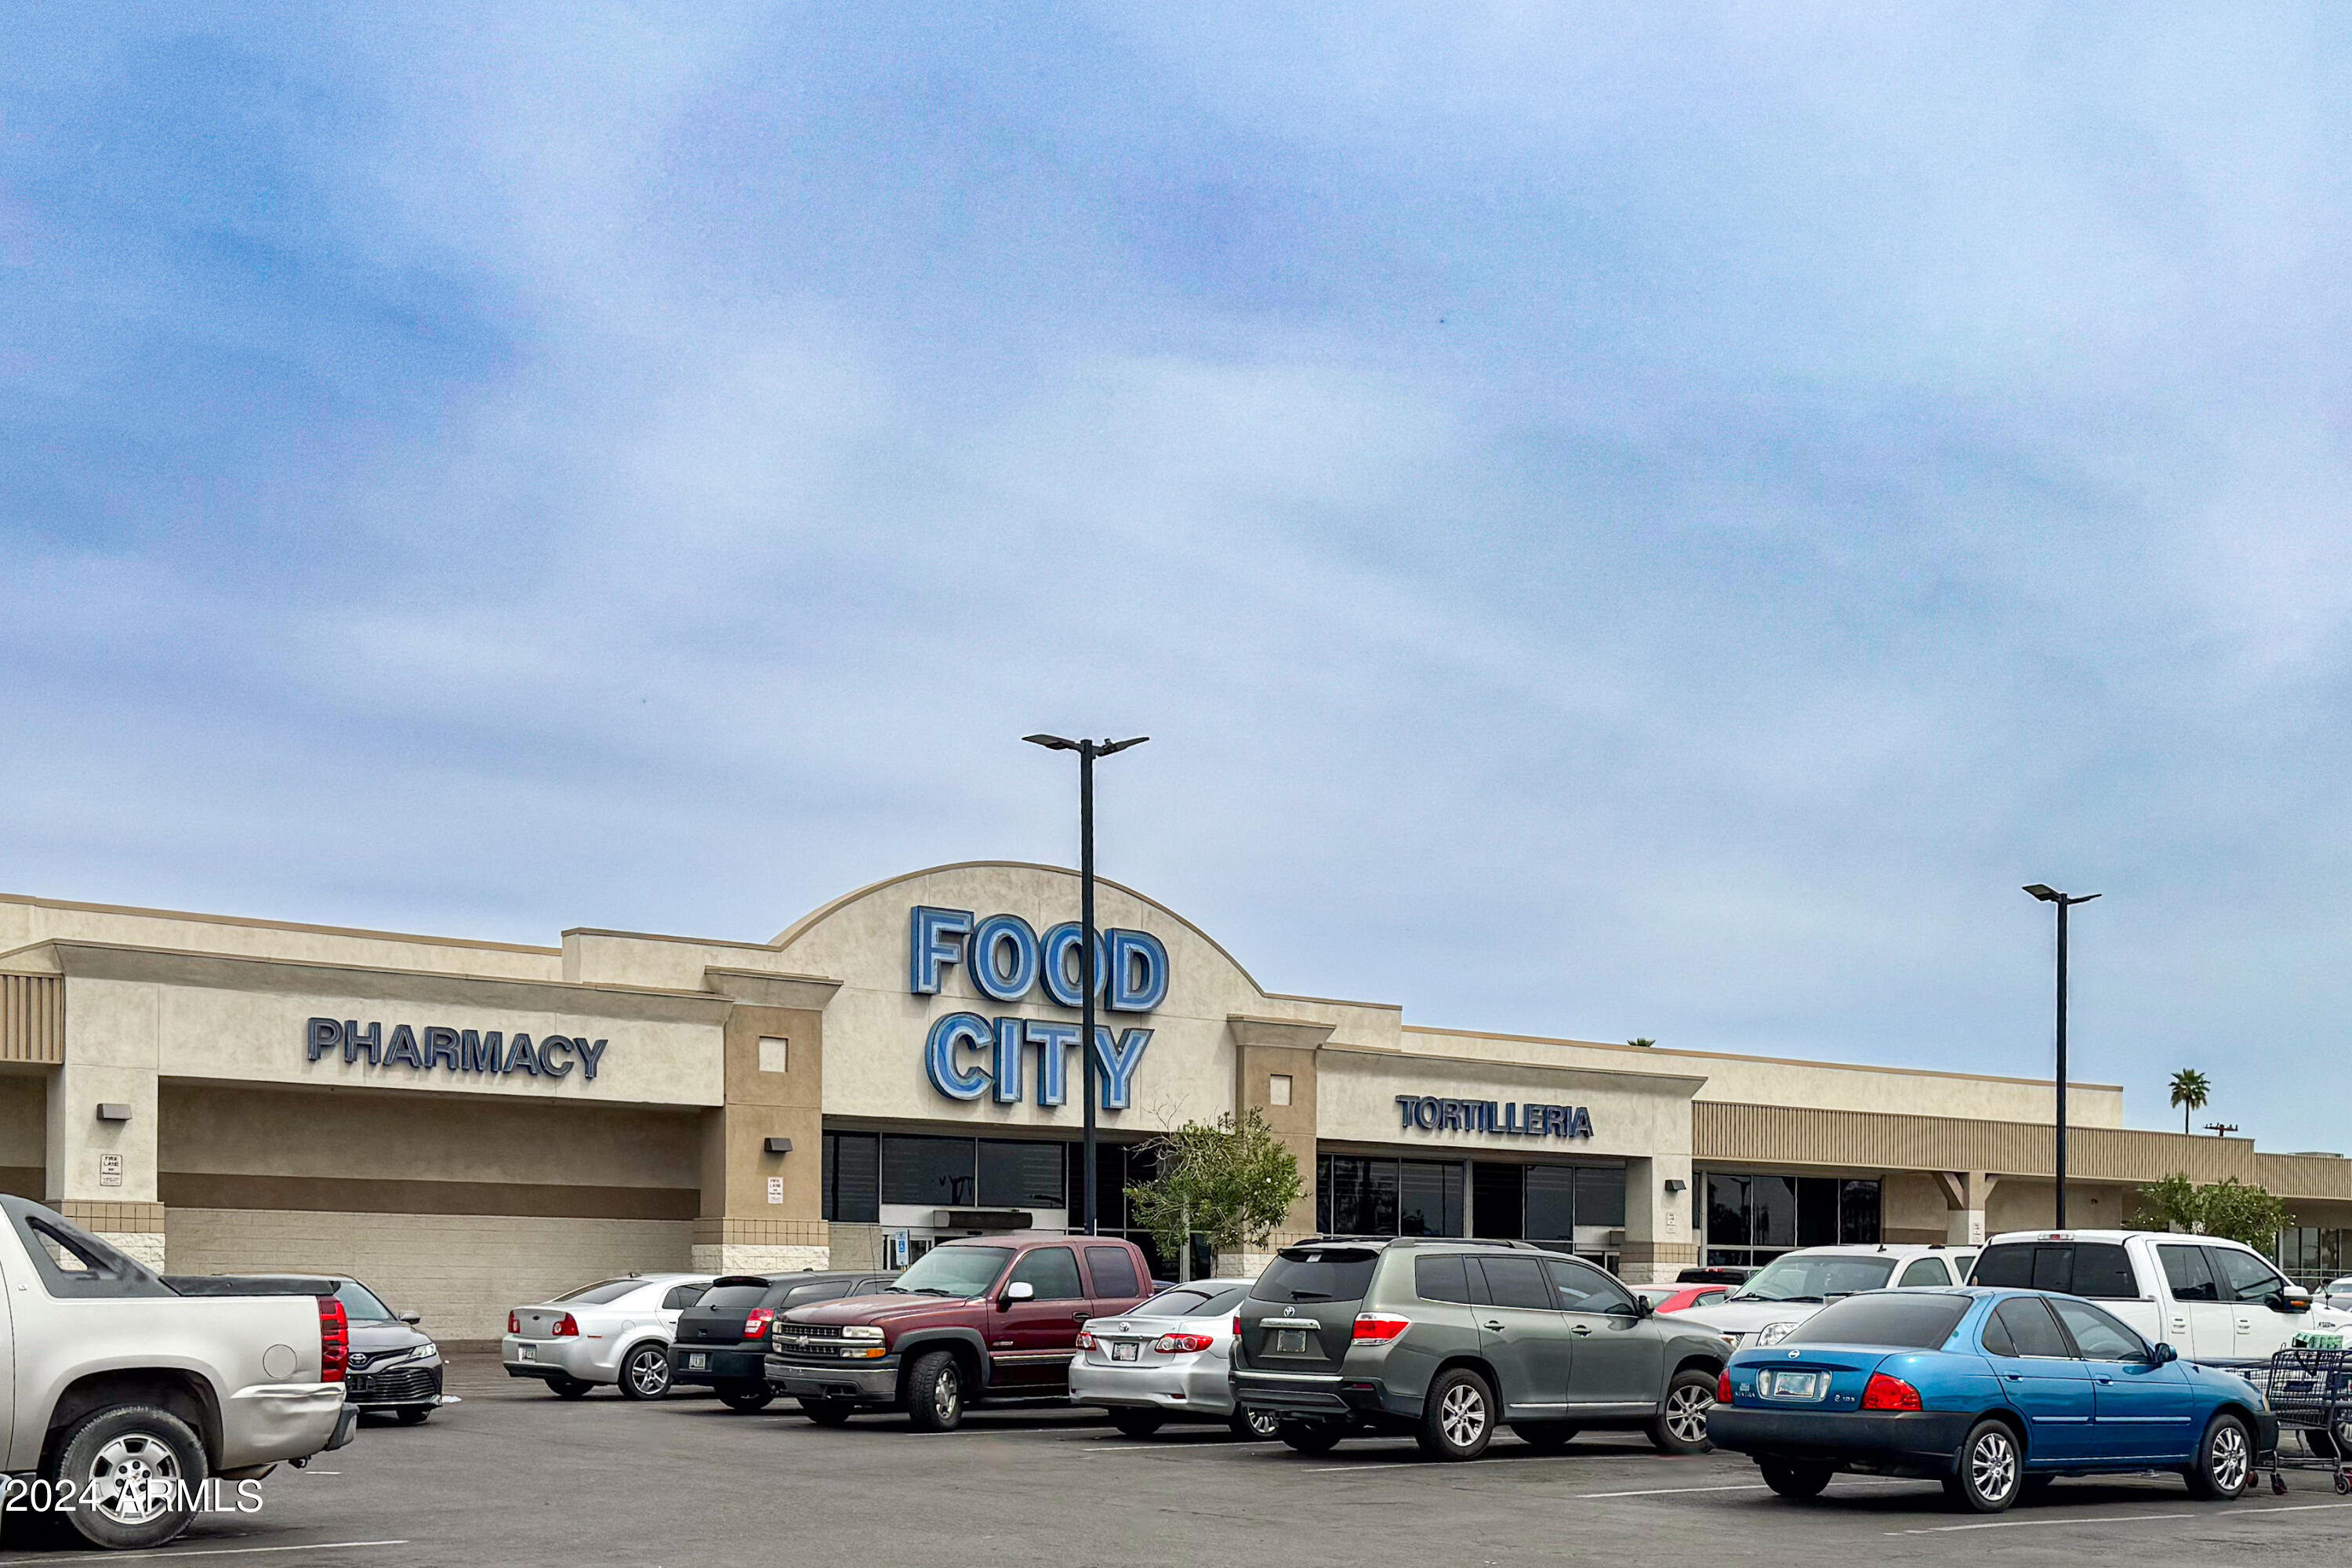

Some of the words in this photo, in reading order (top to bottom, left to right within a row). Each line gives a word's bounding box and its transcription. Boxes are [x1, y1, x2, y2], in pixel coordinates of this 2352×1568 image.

[911, 906, 1170, 1012] FOOD
[307, 1018, 608, 1079] PHARMACY
[925, 1011, 1156, 1109] CITY
[1396, 1095, 1595, 1138] TORTILLERIA
